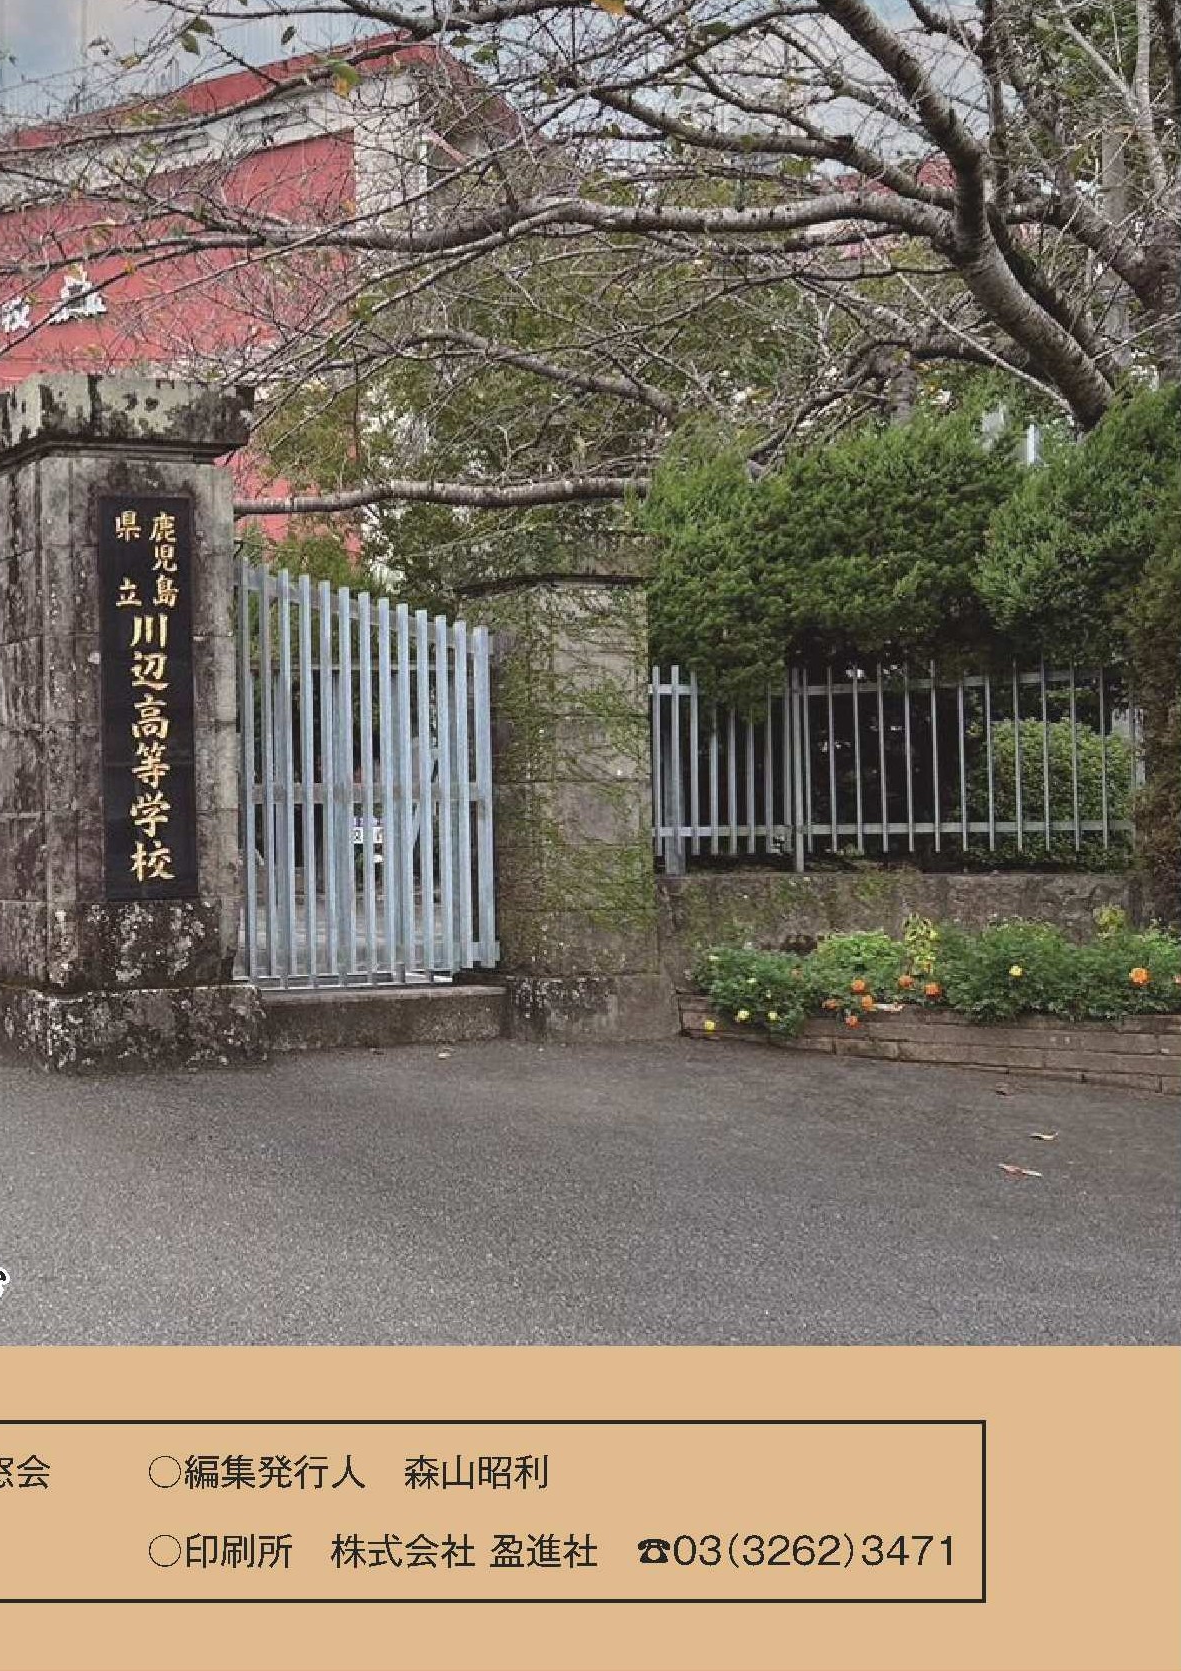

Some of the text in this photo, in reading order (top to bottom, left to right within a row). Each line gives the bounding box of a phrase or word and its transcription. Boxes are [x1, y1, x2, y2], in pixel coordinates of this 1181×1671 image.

[116, 511, 141, 606] 県立
[149, 512, 178, 606] 鹿児島
[130, 615, 175, 881] 川辺高等学校
